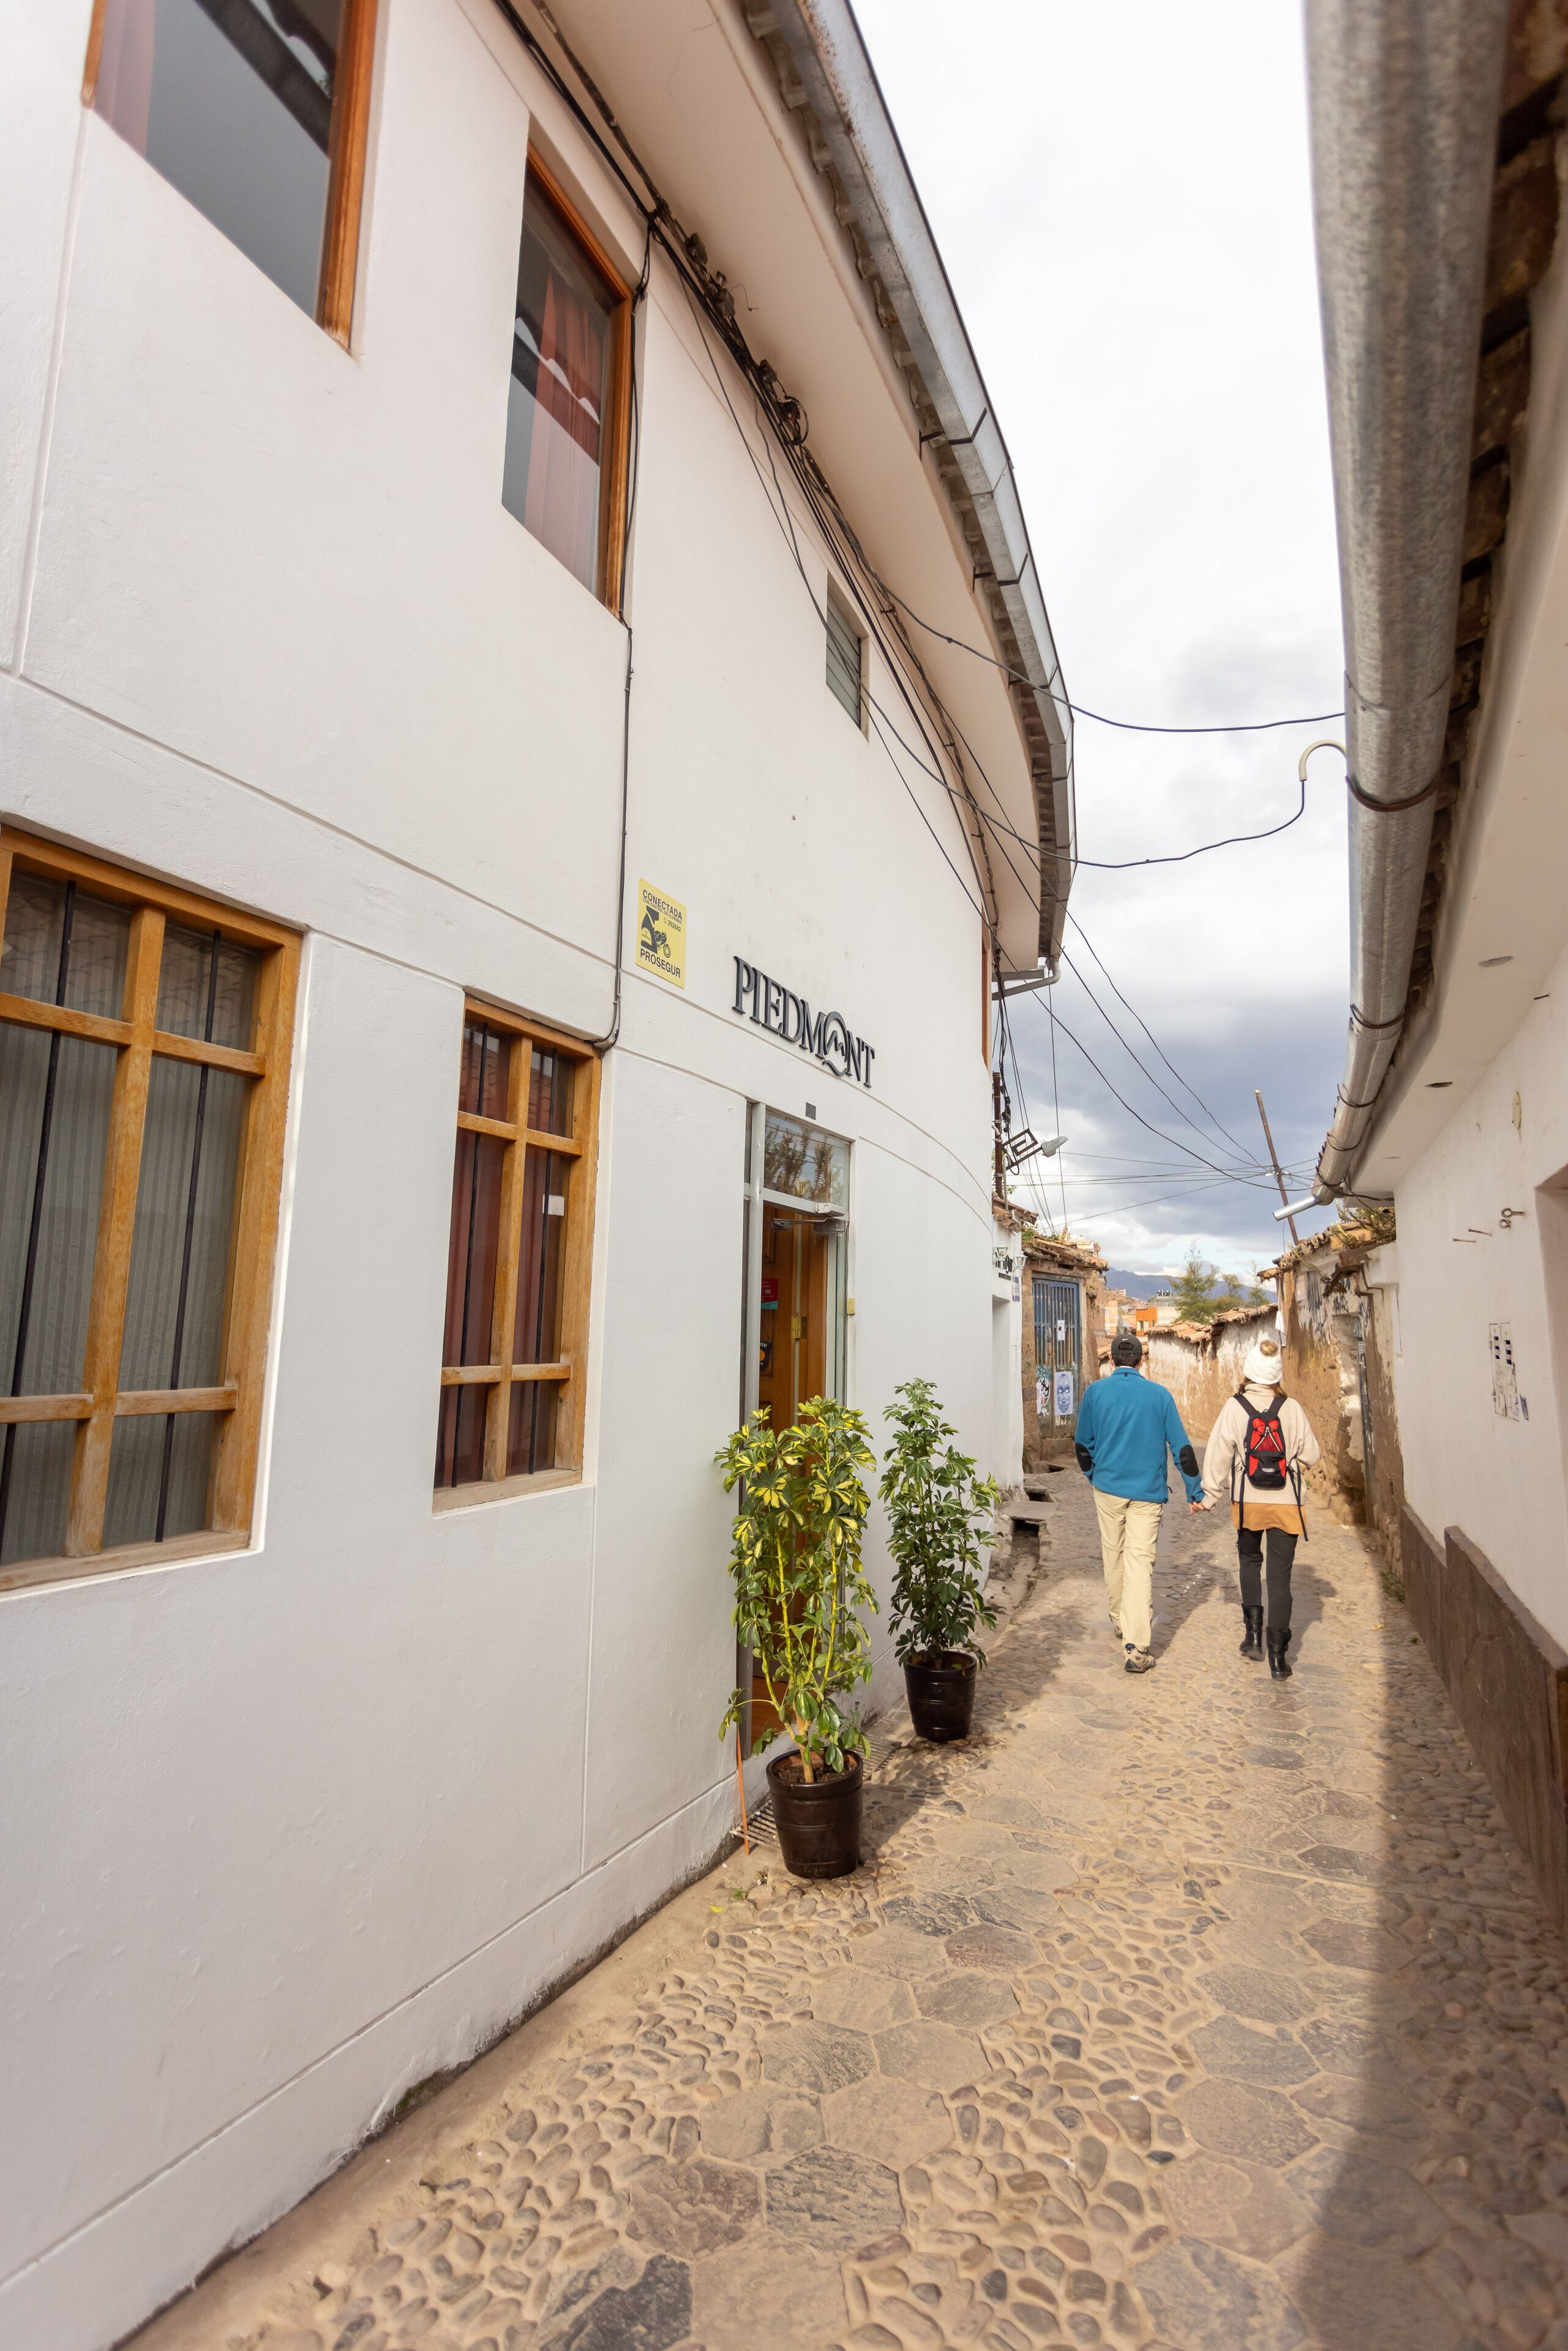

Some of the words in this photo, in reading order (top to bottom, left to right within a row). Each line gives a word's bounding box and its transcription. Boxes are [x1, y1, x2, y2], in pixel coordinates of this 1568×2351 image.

[643, 890, 682, 920] CONECTADA
[650, 902, 664, 913] CENTRAL
[669, 913, 682, 924] ALARMAS
[640, 948, 681, 978] PROSEGUR
[732, 956, 876, 1088] PIEDMONT
